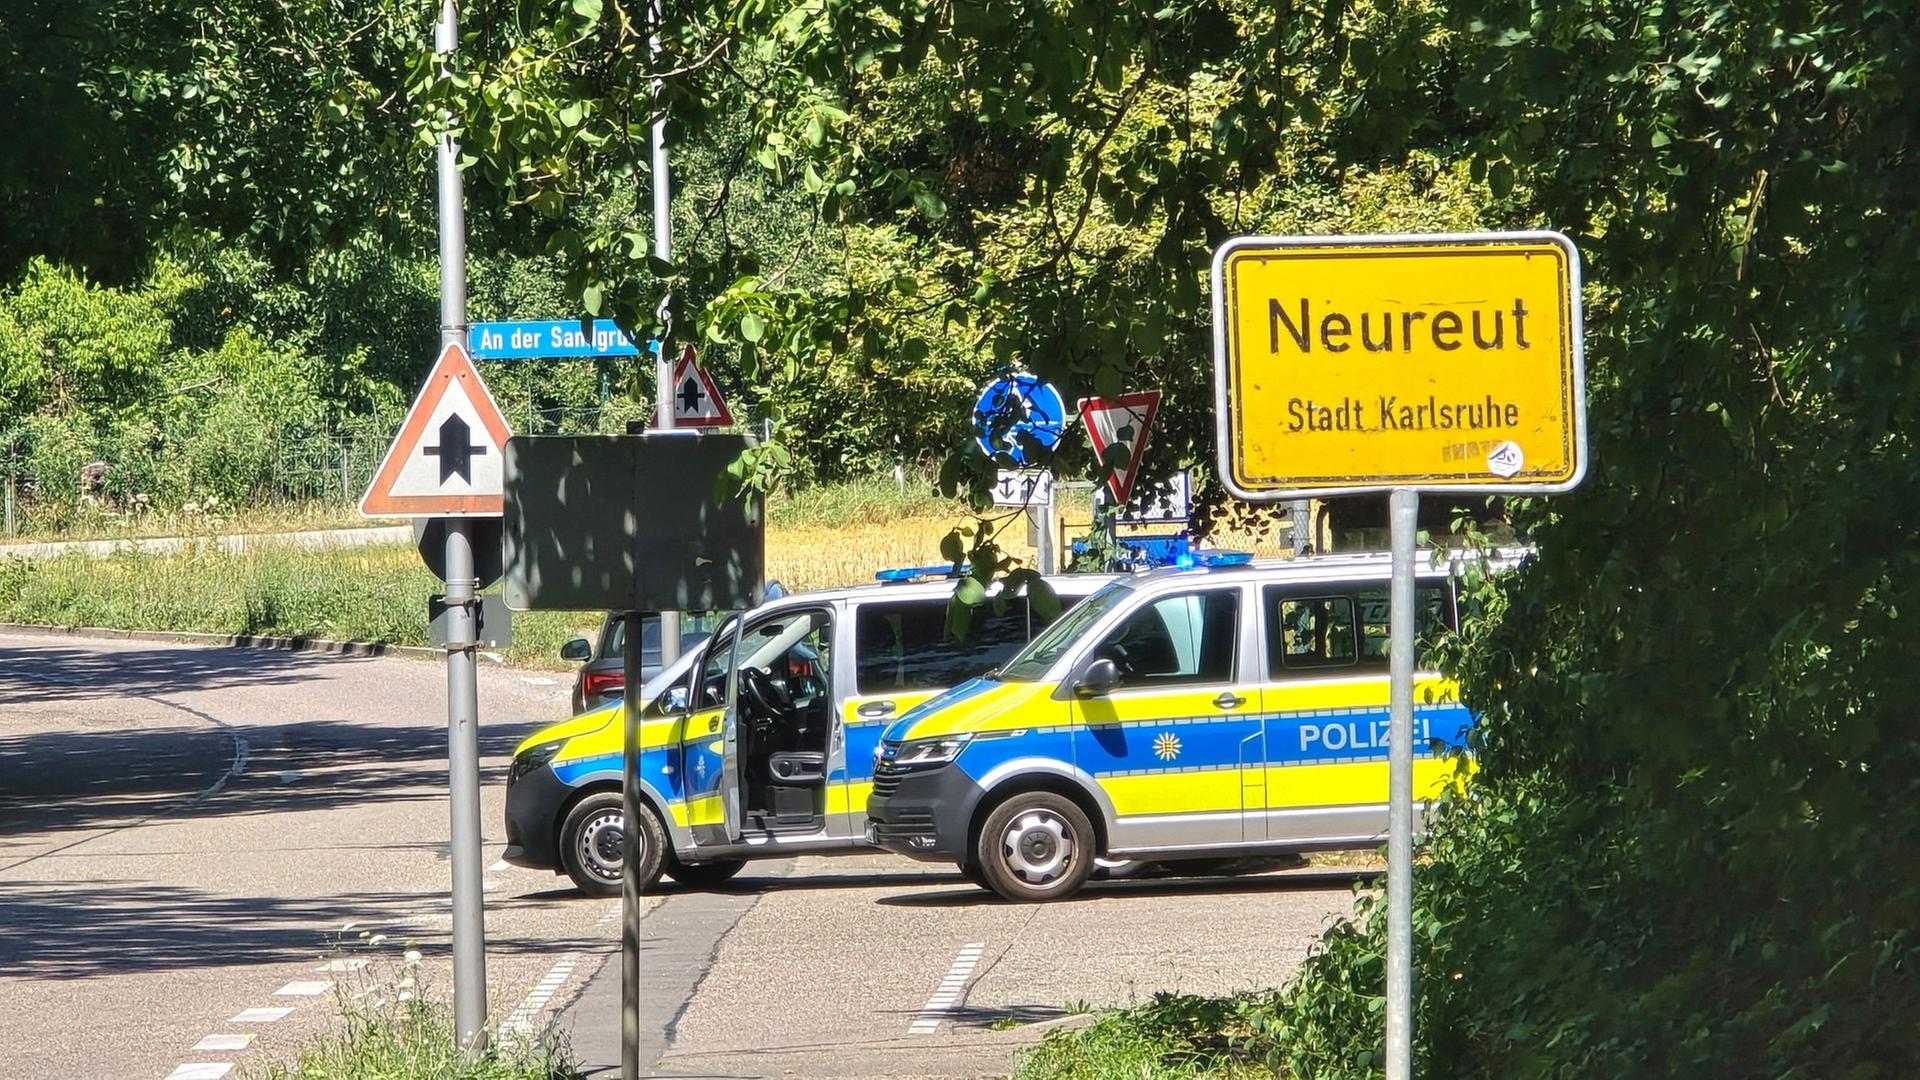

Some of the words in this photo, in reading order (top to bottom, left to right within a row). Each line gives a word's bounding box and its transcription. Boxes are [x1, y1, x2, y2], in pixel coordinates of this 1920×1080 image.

[480, 329, 504, 350] An
[511, 328, 542, 350] der
[551, 327, 637, 353] Sangru
[1269, 298, 1531, 354] Neureut
[1287, 397, 1364, 432] Stadt
[1380, 395, 1520, 431] Karlsruhe
